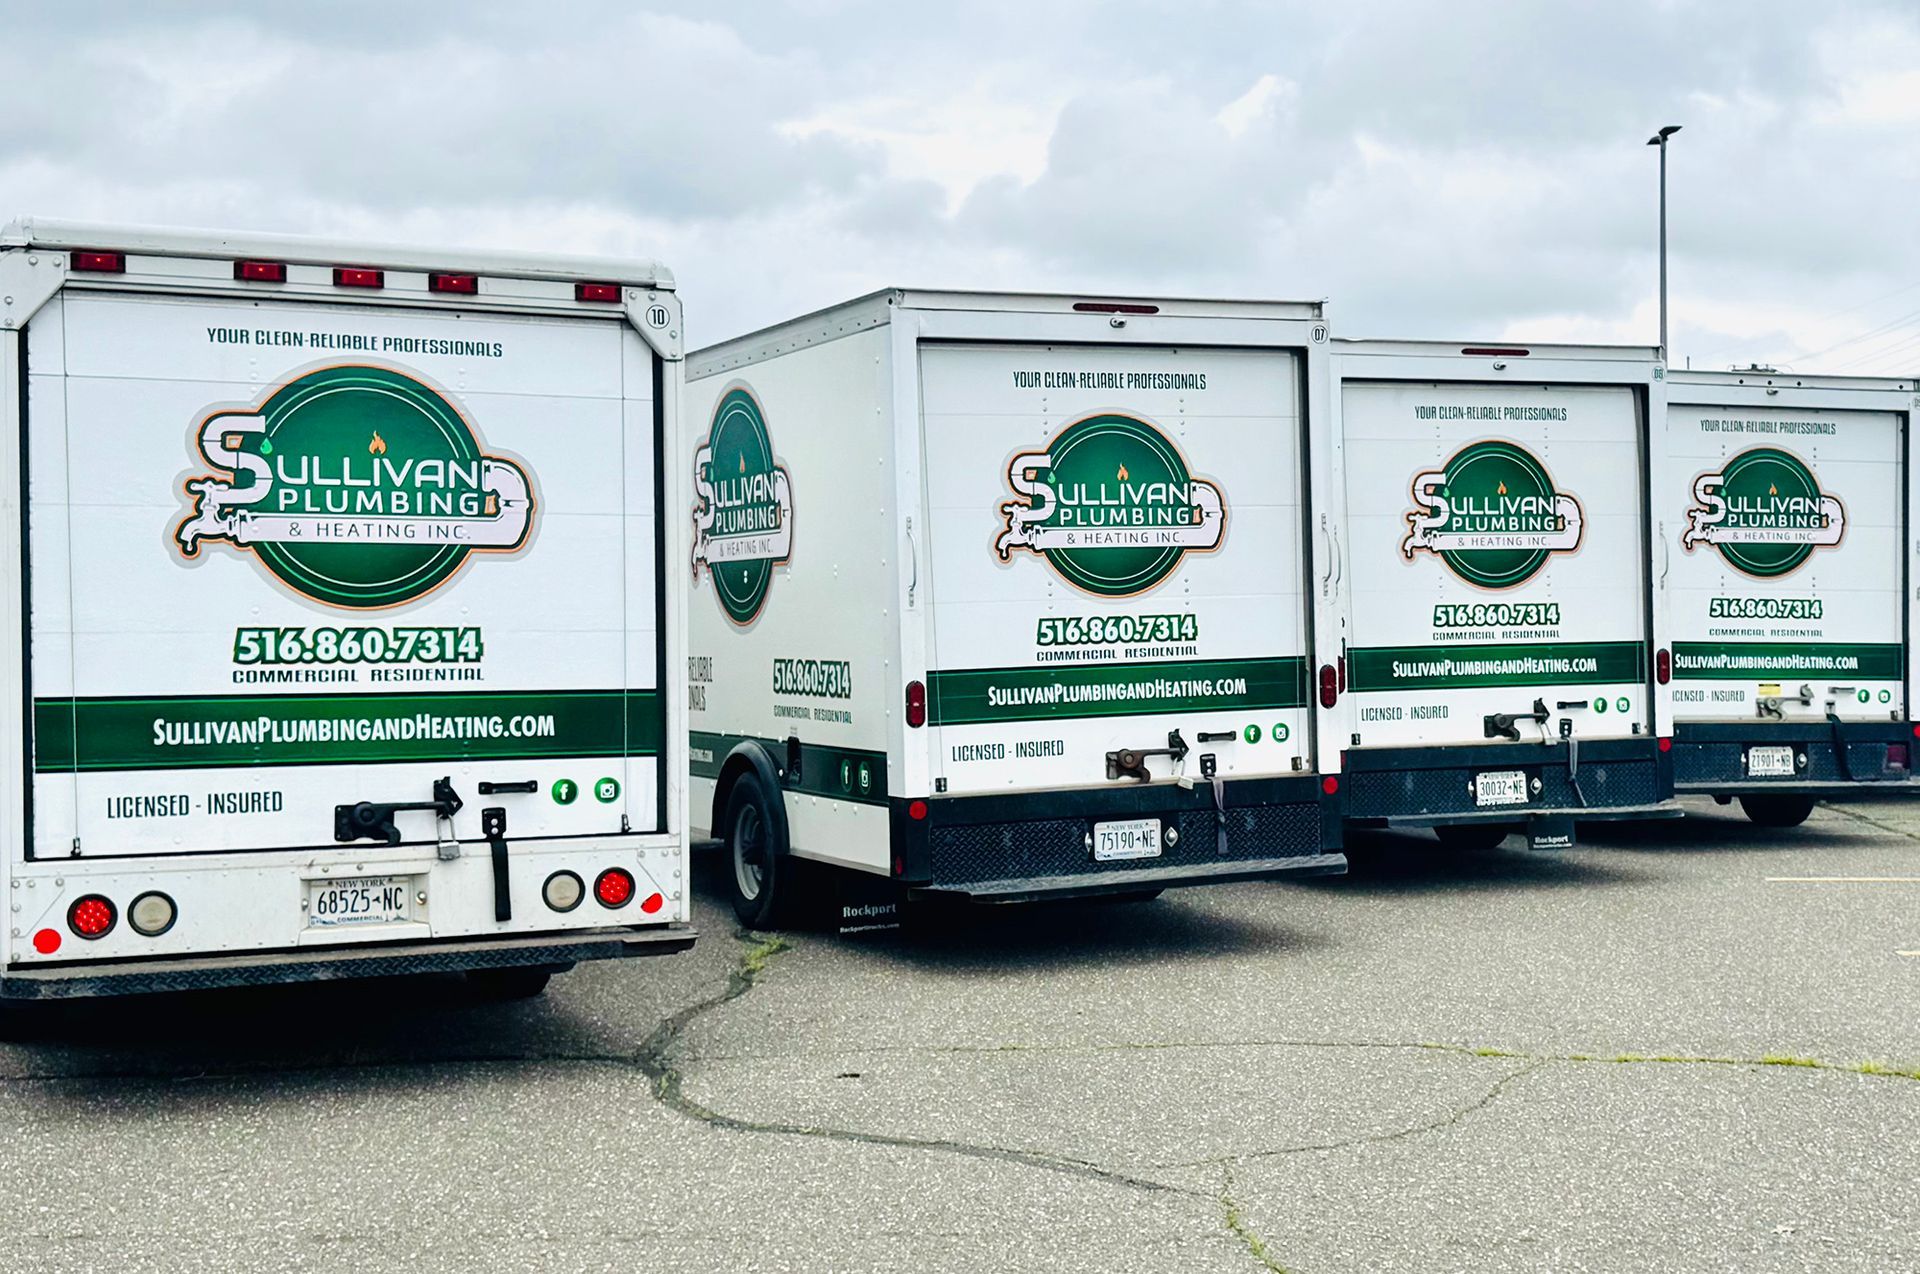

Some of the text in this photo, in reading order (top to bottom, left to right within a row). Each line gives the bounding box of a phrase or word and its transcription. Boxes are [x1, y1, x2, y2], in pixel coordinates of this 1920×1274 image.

[651, 308, 665, 326] 10
[207, 327, 502, 357] YOUR CLEAN-RELIABLE PROFESSIONALS
[1315, 329, 1325, 340] 07
[1014, 371, 1207, 390] YOUR CLEAN-RELIABLE PROFESSIONALS
[1415, 406, 1567, 421] YOUR CLEAN-RELIABLE PROFESSIONALS
[1701, 420, 1836, 434] YOUR CLEAN-RELIABLE PROFESSIONALS
[202, 415, 481, 504] SULLIVAN
[695, 447, 775, 529] SULLIVAN
[1011, 455, 1190, 521] SULLIVAN
[279, 489, 479, 515] PLUMBING
[1413, 473, 1554, 528] SULLIVAN
[1695, 476, 1819, 523] SULLIVAN
[716, 506, 775, 533] PLUMBING
[1060, 507, 1189, 526] PLUMBING
[1452, 516, 1555, 531] PLUMBING
[1728, 515, 1819, 527] PLUMBING
[289, 521, 471, 539] & HEATING INC.
[1067, 532, 1184, 544] & HEATING INC.
[1745, 532, 1790, 540] HEATING
[727, 540, 756, 555] HEATING
[1458, 537, 1550, 546] & HEATING INC.
[1433, 603, 1560, 627] 516.860.7314
[1710, 598, 1822, 618] 516.860.7314
[1037, 615, 1198, 646] 516.860.7314
[1433, 630, 1559, 641] COMMERCIAL RESIDENTIAL
[1771, 629, 1822, 637] RESIDENTIAL
[233, 627, 484, 664] 516.860.7314
[1037, 646, 1198, 661] COMMERCIAL RESIDENTIAL
[233, 666, 484, 684] COMMERCIAL RESIDENTIAL
[774, 659, 850, 698] 516.860.7314
[1672, 690, 1705, 702] ICENSED
[1711, 690, 1745, 702] INSURED
[774, 705, 852, 724] COMMERCIAL RESIDENTIAL
[1361, 707, 1402, 721] LICENSED
[1411, 705, 1448, 719] INSURED
[952, 743, 1005, 762] LICENSED
[1016, 740, 1064, 758] INSURED
[107, 794, 189, 818] LICENSED
[207, 791, 283, 814] INSURED
[336, 879, 386, 889] NEW YORK
[843, 904, 896, 917] Rockport
